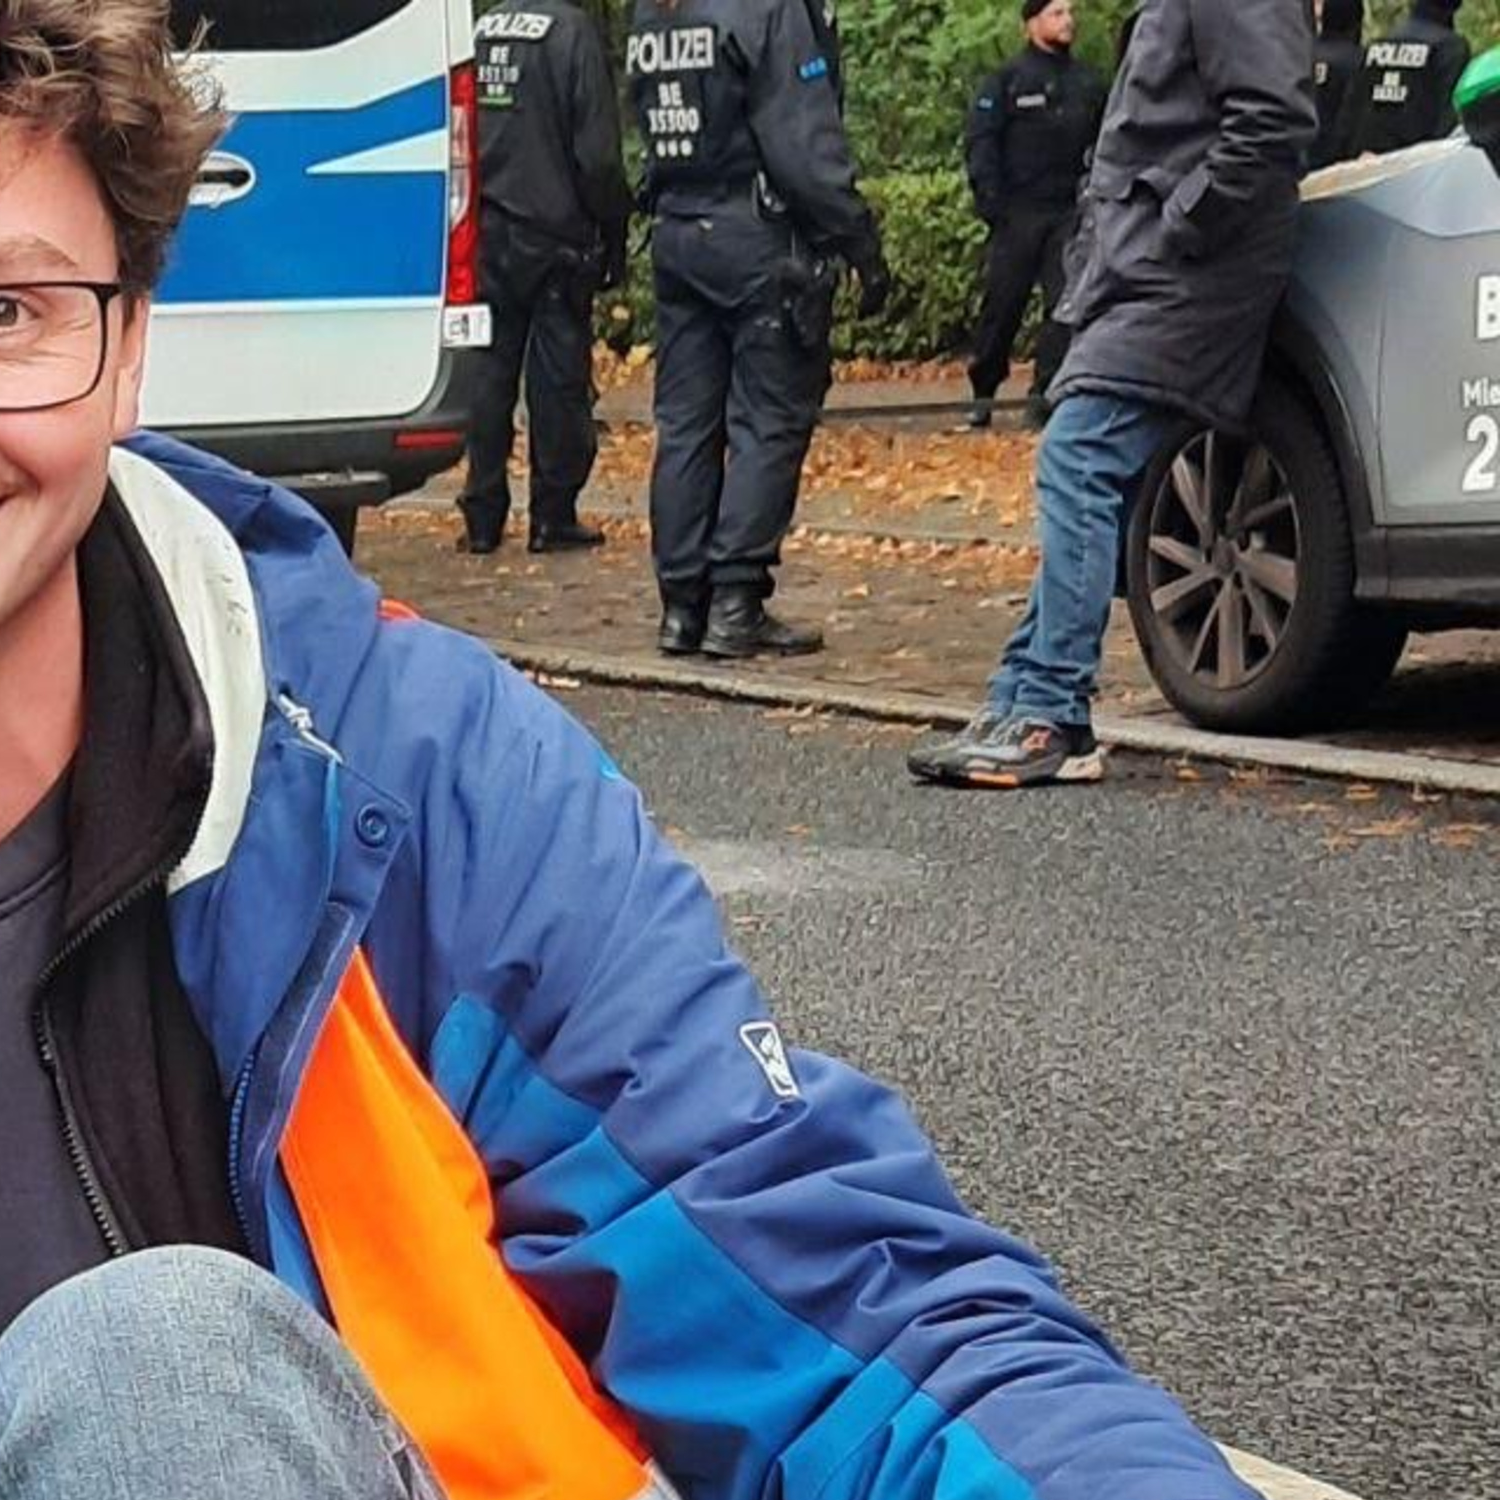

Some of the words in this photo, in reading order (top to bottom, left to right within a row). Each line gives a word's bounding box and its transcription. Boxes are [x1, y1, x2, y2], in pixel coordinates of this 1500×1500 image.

[474, 13, 552, 39] POLIZEI
[626, 27, 714, 75] POLIZEI
[1366, 42, 1429, 68] POLIZEI
[658, 81, 682, 107] BE
